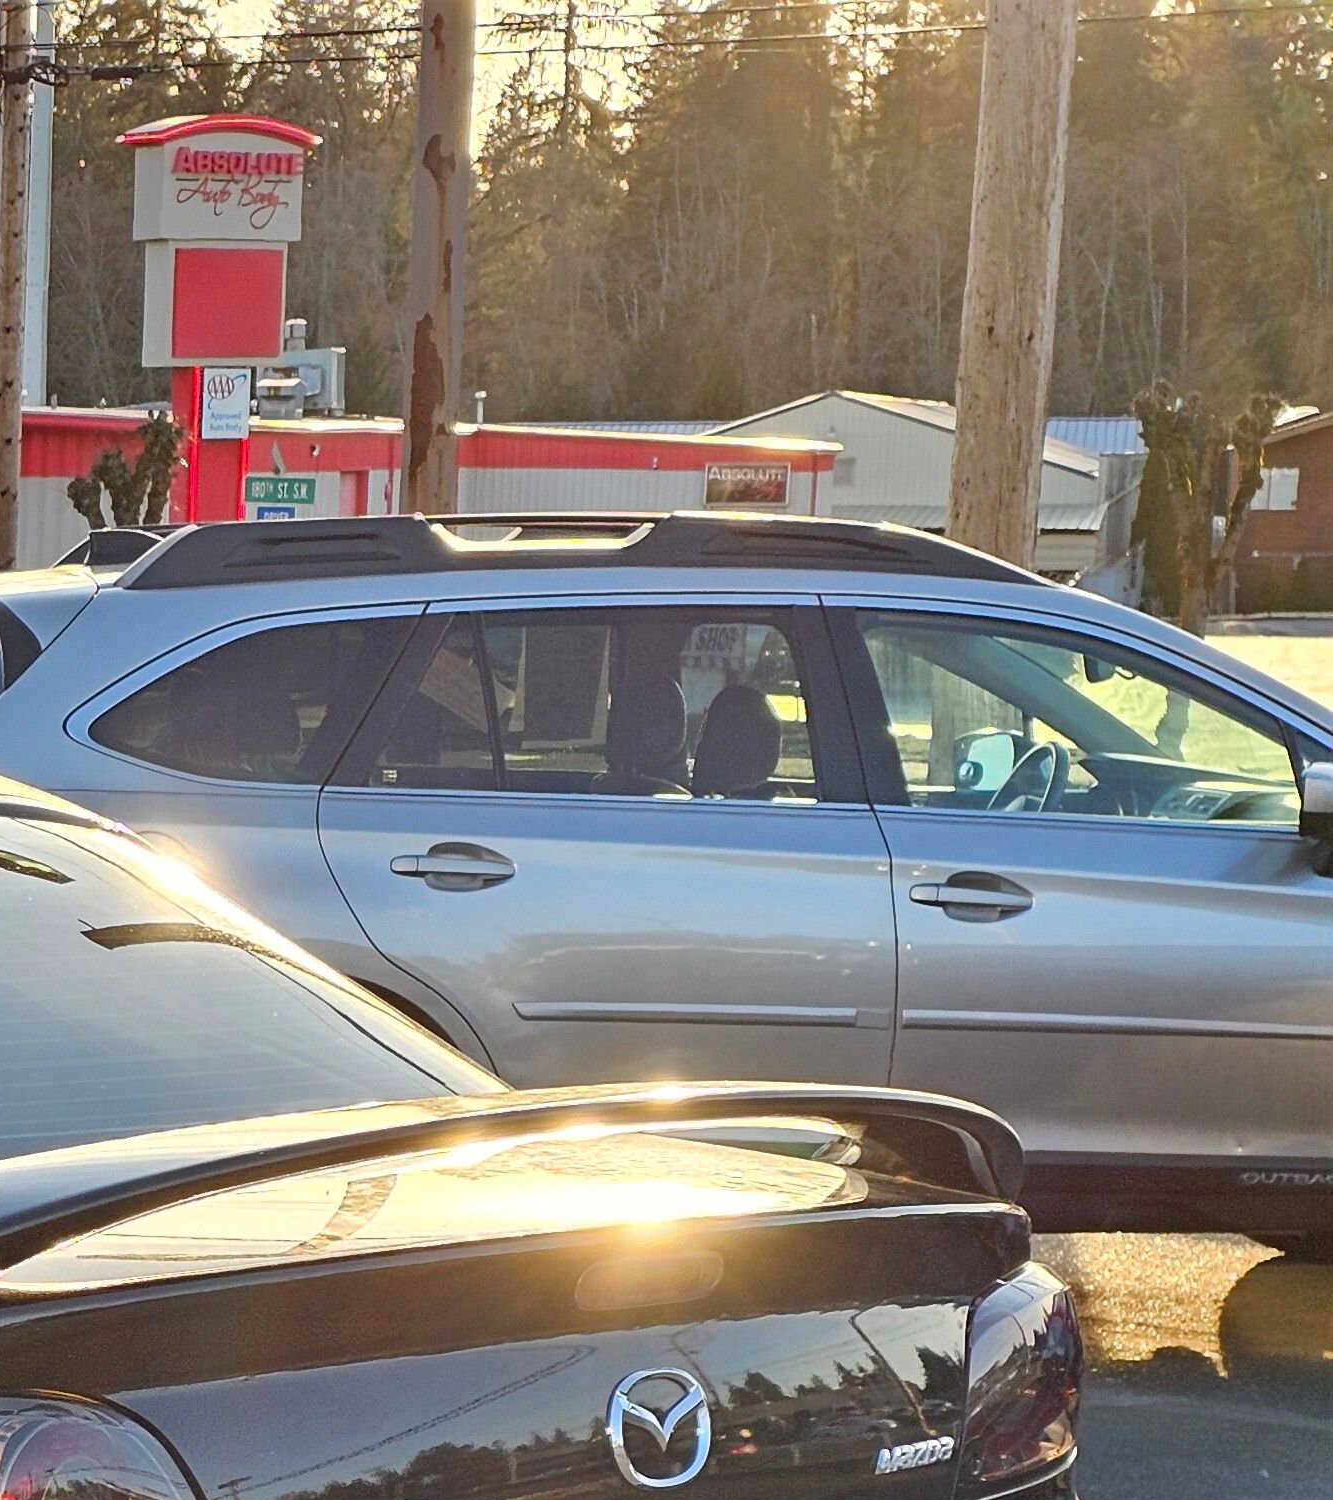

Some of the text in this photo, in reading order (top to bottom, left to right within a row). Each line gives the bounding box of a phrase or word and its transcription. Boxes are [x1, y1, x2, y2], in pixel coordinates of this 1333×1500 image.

[173, 146, 304, 175] ABSOLUTE
[176, 174, 289, 229] Auto Body
